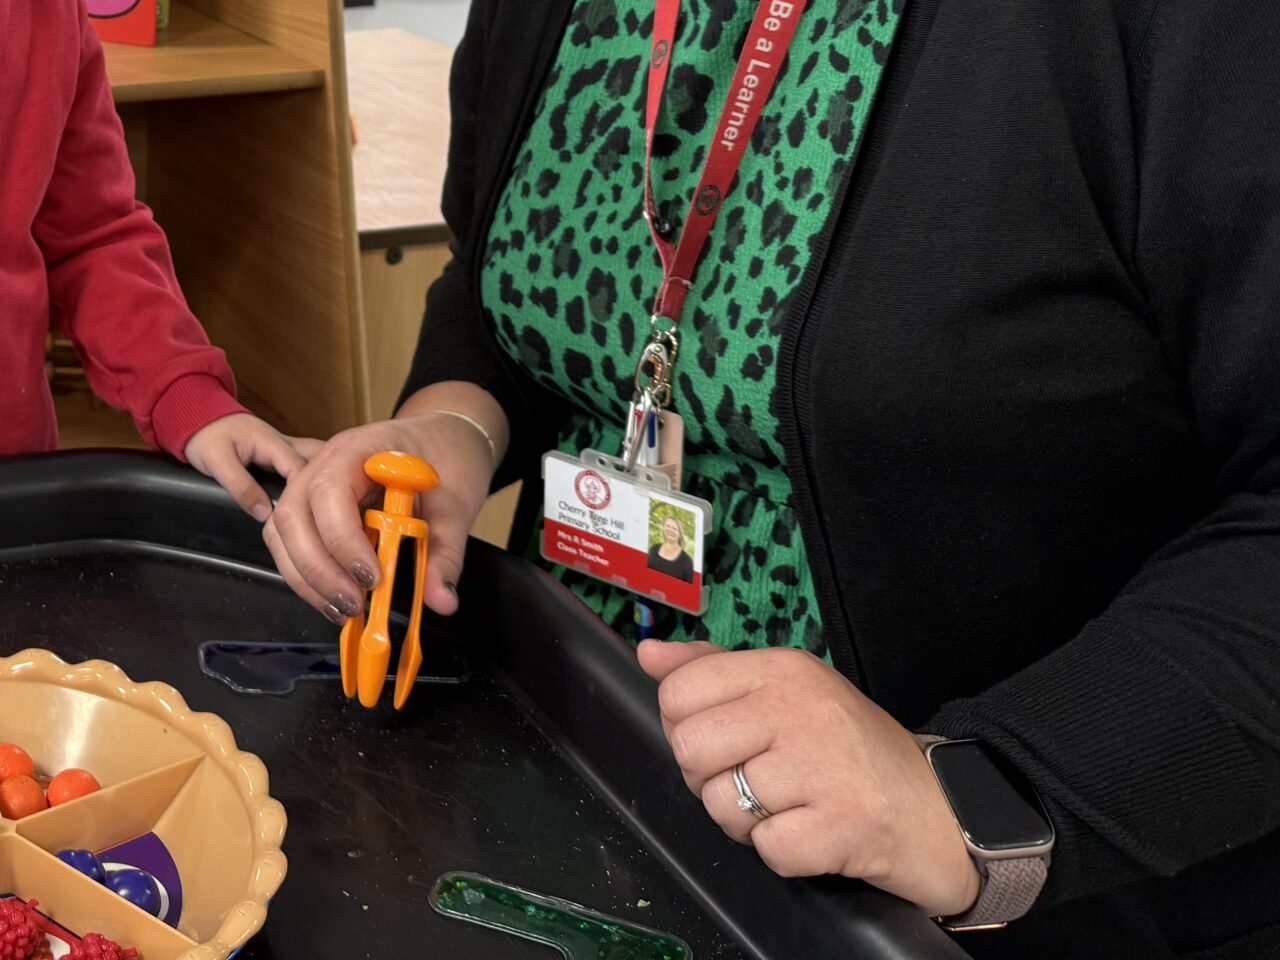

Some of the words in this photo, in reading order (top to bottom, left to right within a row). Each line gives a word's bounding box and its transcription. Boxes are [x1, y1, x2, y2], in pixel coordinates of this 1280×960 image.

[756, 37, 771, 51] a
[719, 58, 772, 152] Learner
[558, 500, 587, 518] Cherry
[610, 518, 625, 530] Hill
[558, 512, 590, 530] Primary
[592, 524, 621, 540] School
[556, 541, 578, 555] Class
[578, 549, 610, 566] Teacher
[581, 538, 604, 553] Smith
